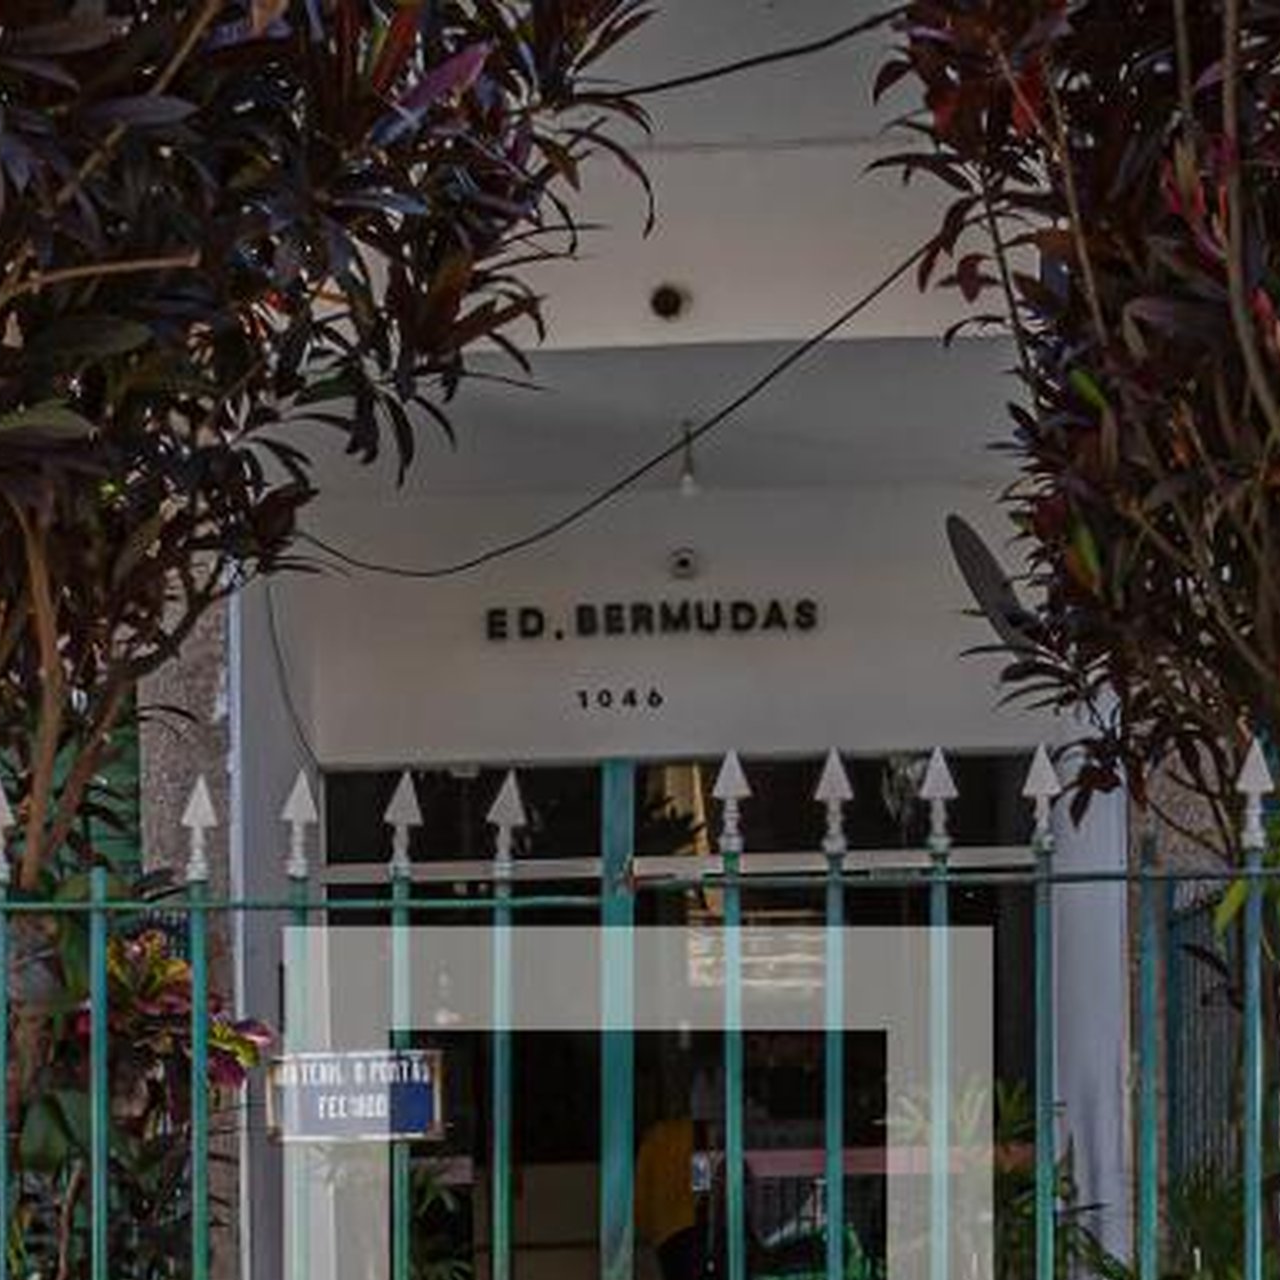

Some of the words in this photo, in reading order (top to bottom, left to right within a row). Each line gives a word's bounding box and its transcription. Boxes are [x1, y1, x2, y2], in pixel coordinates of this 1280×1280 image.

[485, 607, 563, 641] ED.
[574, 600, 819, 637] BERMUDAS
[576, 690, 663, 709] 1046
